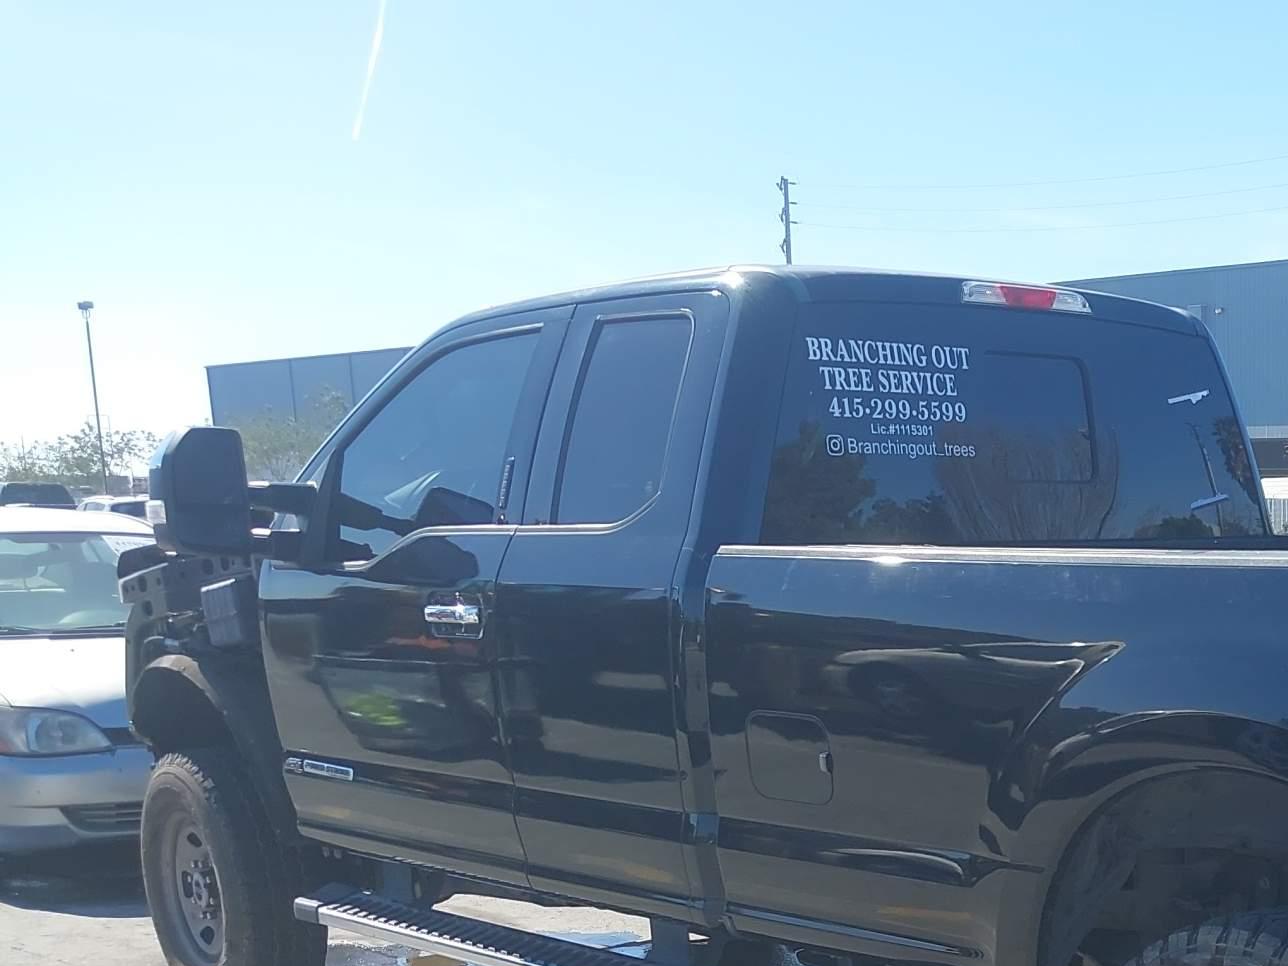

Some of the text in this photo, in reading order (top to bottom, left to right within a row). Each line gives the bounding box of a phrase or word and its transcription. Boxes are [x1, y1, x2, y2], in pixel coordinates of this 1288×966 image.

[806, 337, 969, 370] BRANCHING OUT
[819, 366, 957, 396] TREE SERVICE
